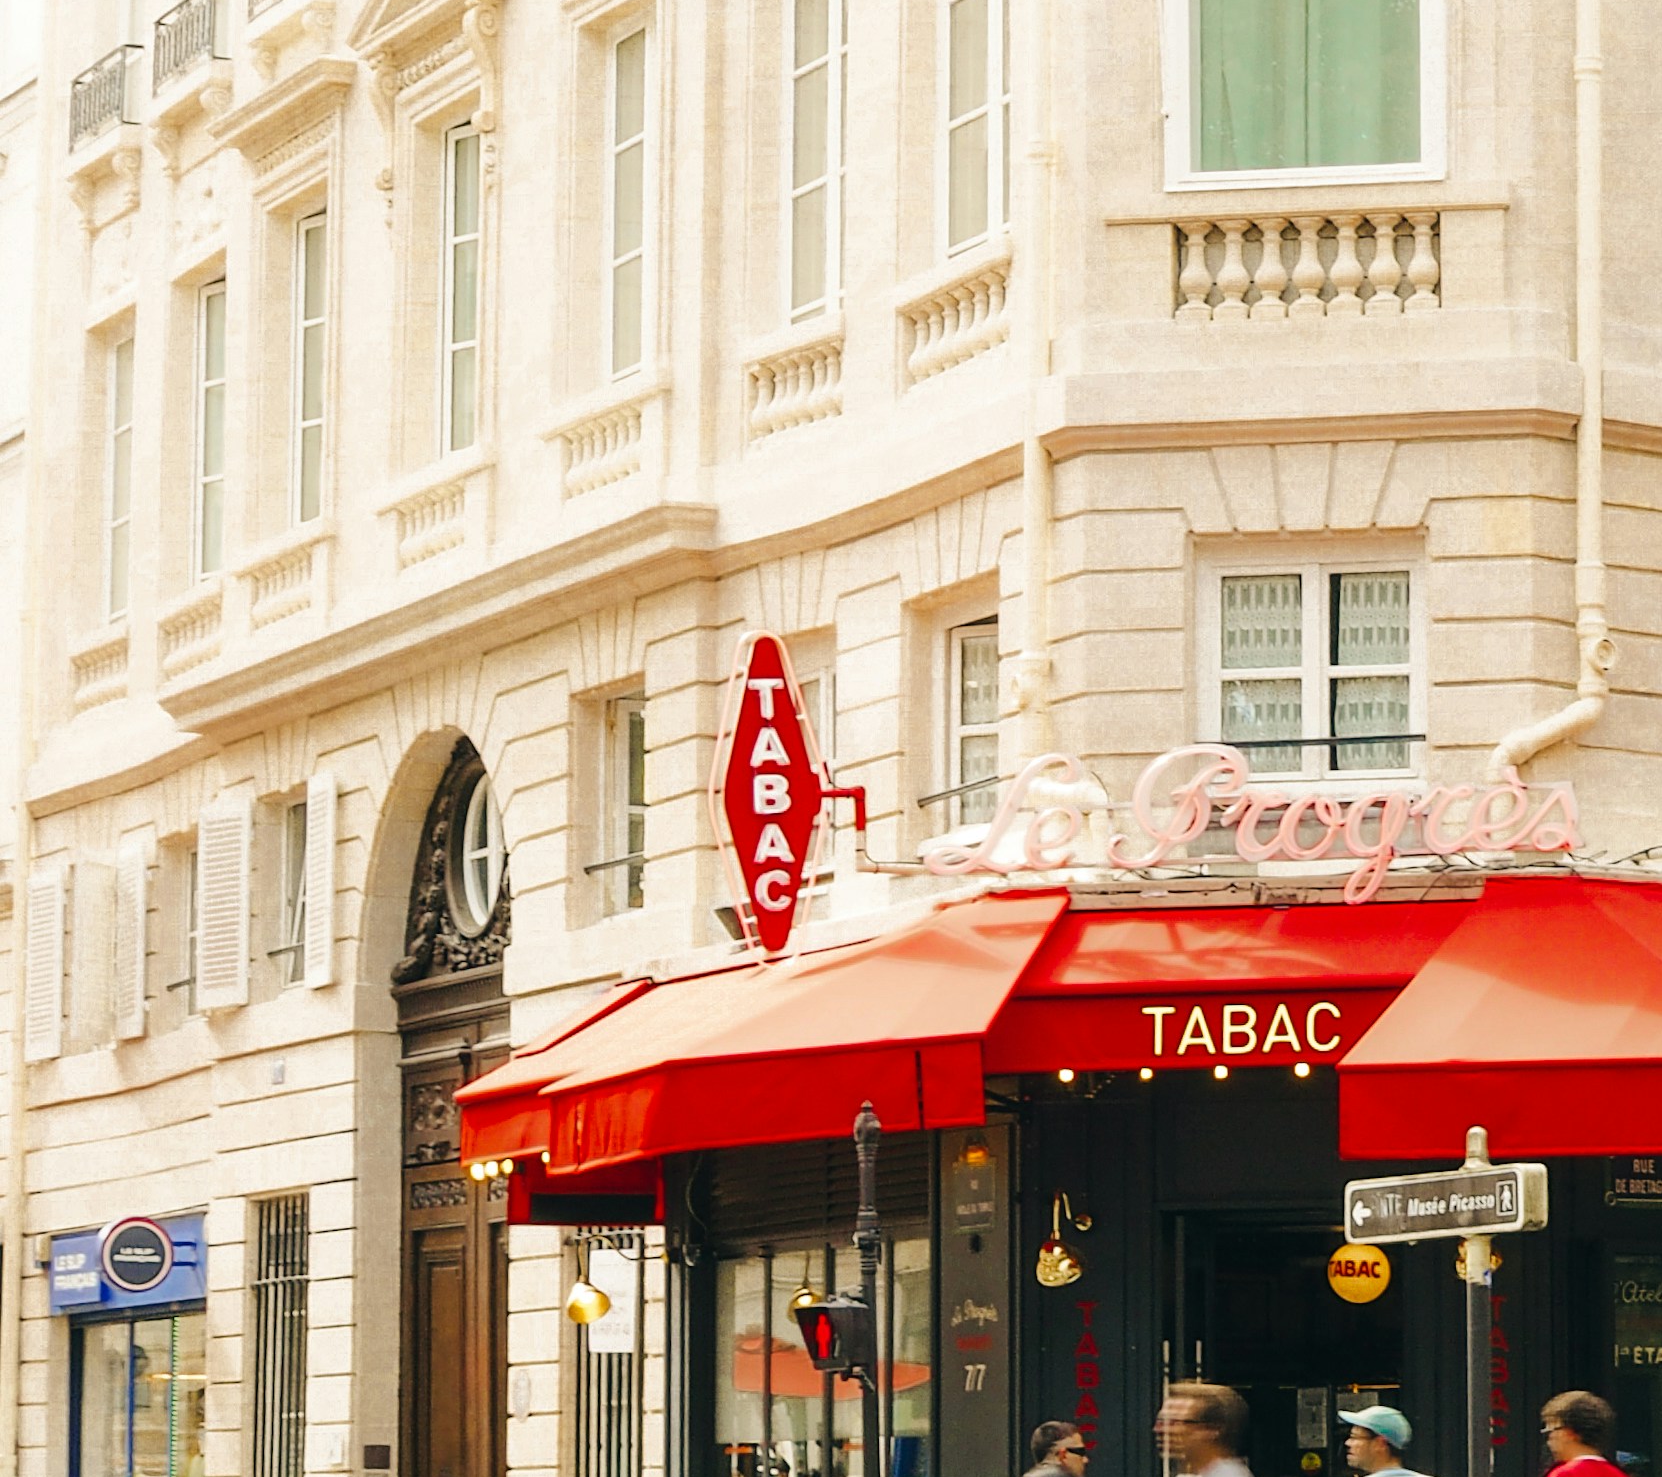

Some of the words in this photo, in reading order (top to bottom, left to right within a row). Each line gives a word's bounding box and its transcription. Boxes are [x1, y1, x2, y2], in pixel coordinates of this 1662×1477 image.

[747, 677, 794, 913] TABAC
[924, 753, 1085, 877] Le
[1106, 742, 1581, 905] Progrès
[1142, 1001, 1343, 1056] TABAC
[1632, 1158, 1656, 1174] RUE
[1407, 1195, 1447, 1217] Musée
[1449, 1192, 1496, 1213] Picasso
[1328, 1259, 1381, 1279] TABAC
